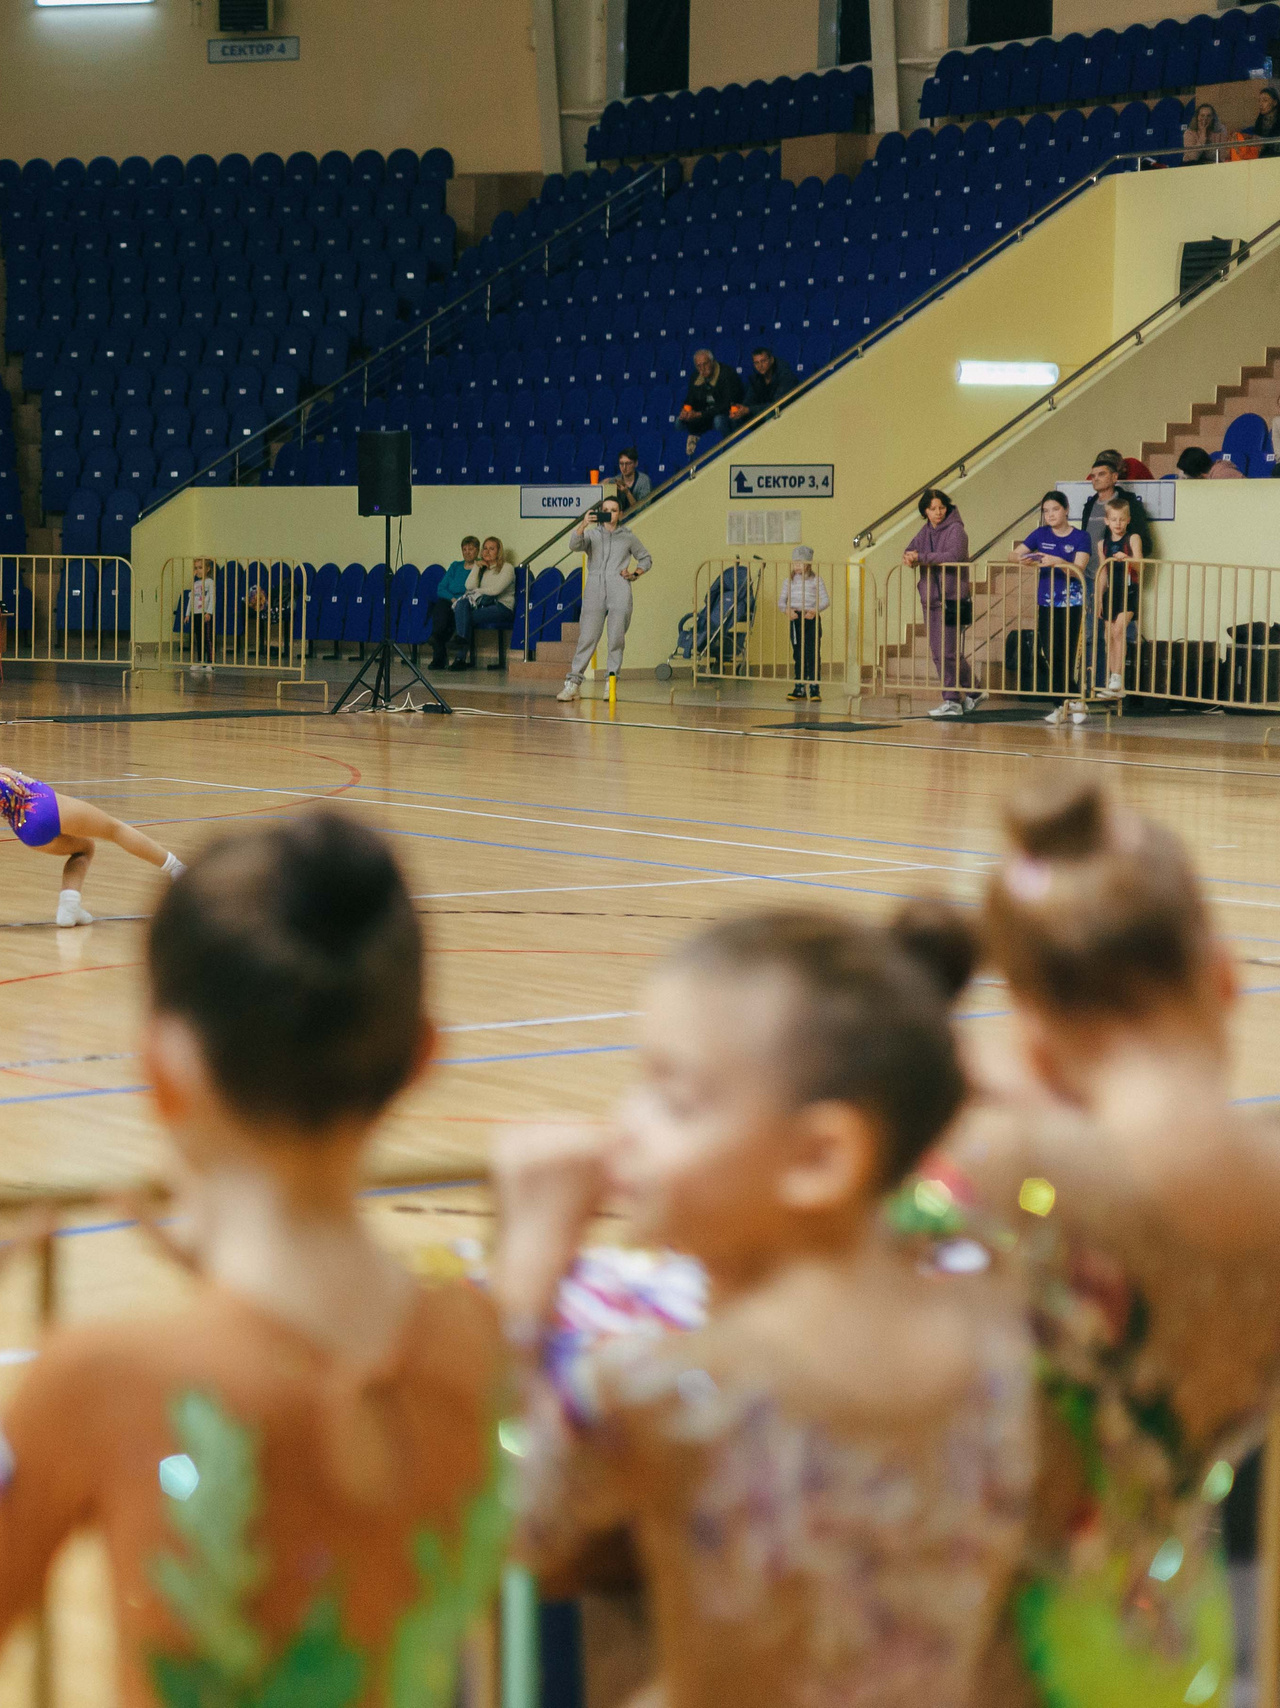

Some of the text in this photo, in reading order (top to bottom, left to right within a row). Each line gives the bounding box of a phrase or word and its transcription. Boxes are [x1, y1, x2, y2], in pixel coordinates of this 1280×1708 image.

[221, 42, 286, 56] СЕКТОР 4
[757, 475, 805, 488] СЕКТОР
[821, 475, 830, 488] 4
[541, 496, 581, 507] СЕКТОР 3
